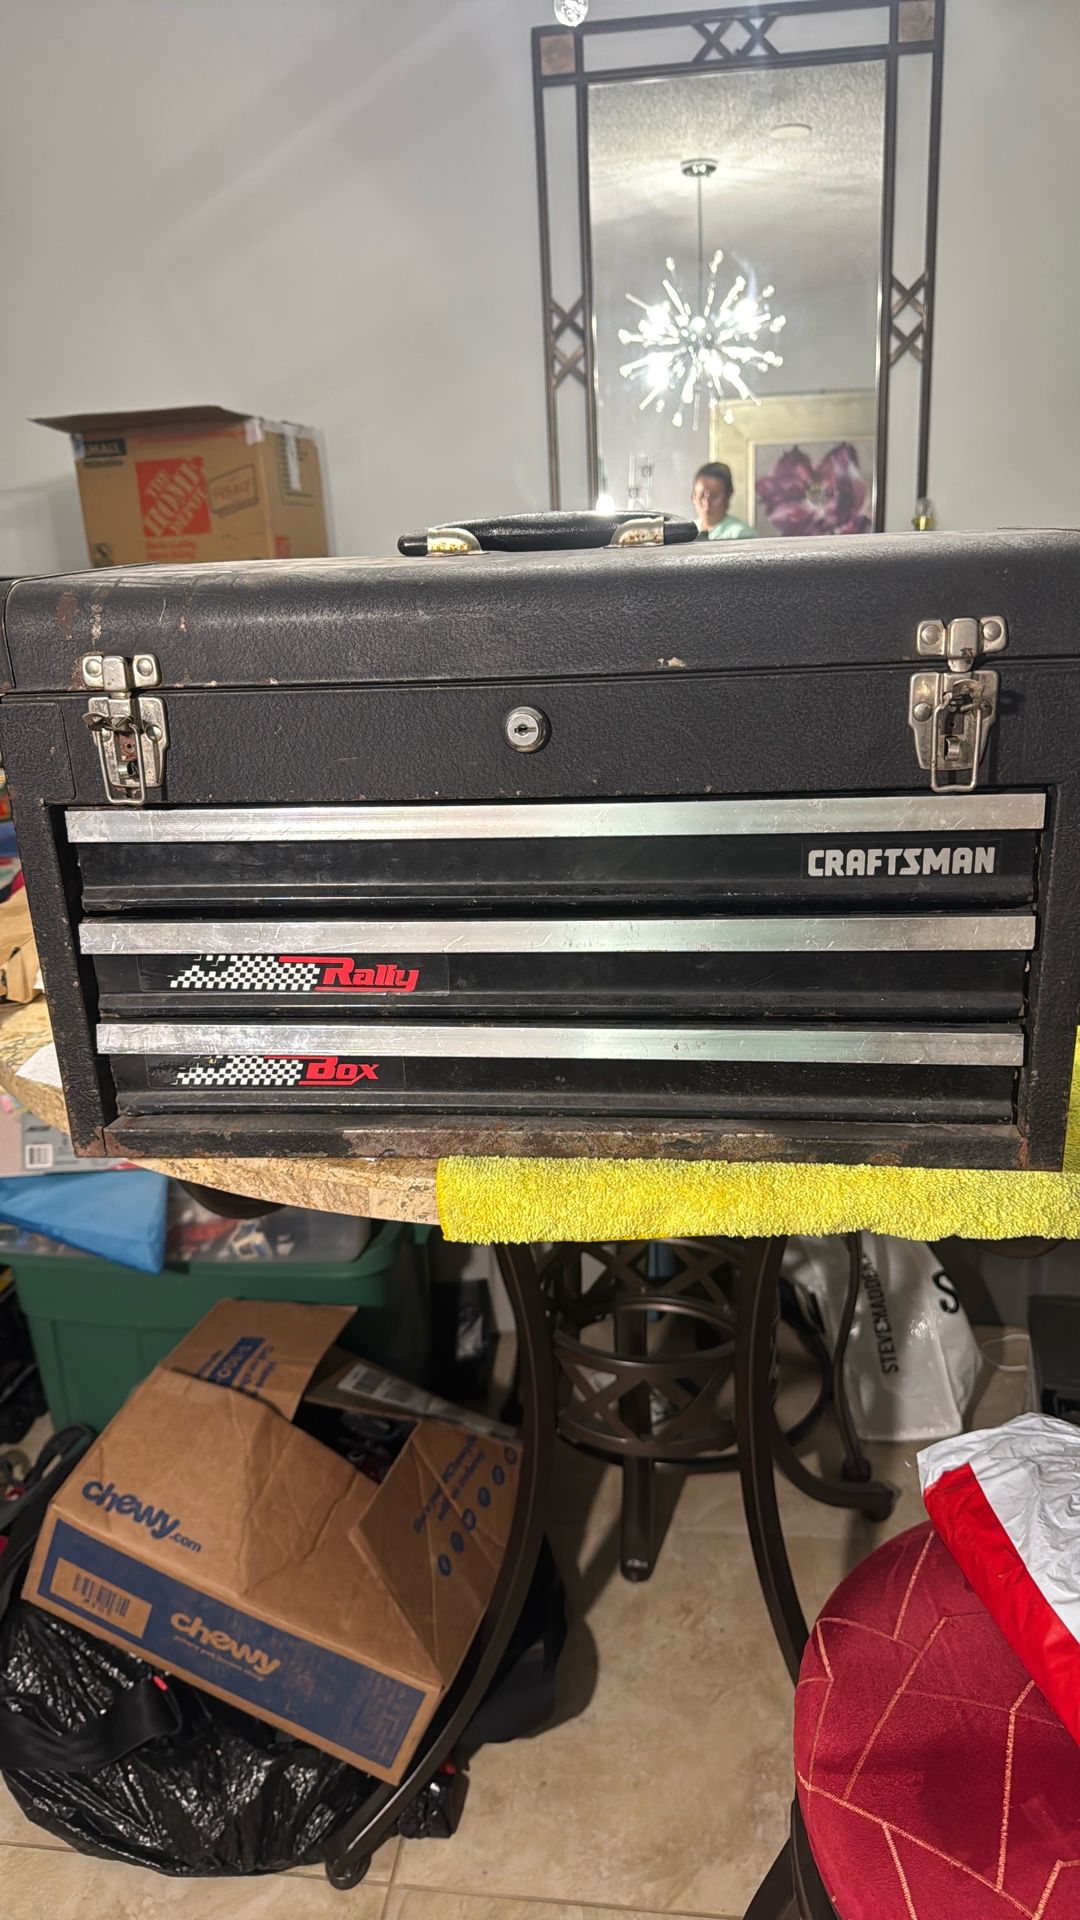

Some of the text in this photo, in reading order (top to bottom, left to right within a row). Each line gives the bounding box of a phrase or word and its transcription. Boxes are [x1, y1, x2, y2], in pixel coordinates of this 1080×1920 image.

[807, 847, 996, 877] CRAFTSMAN
[314, 955, 420, 992] Rally
[299, 1055, 380, 1086] Box
[170, 1612, 281, 1676] chewy
